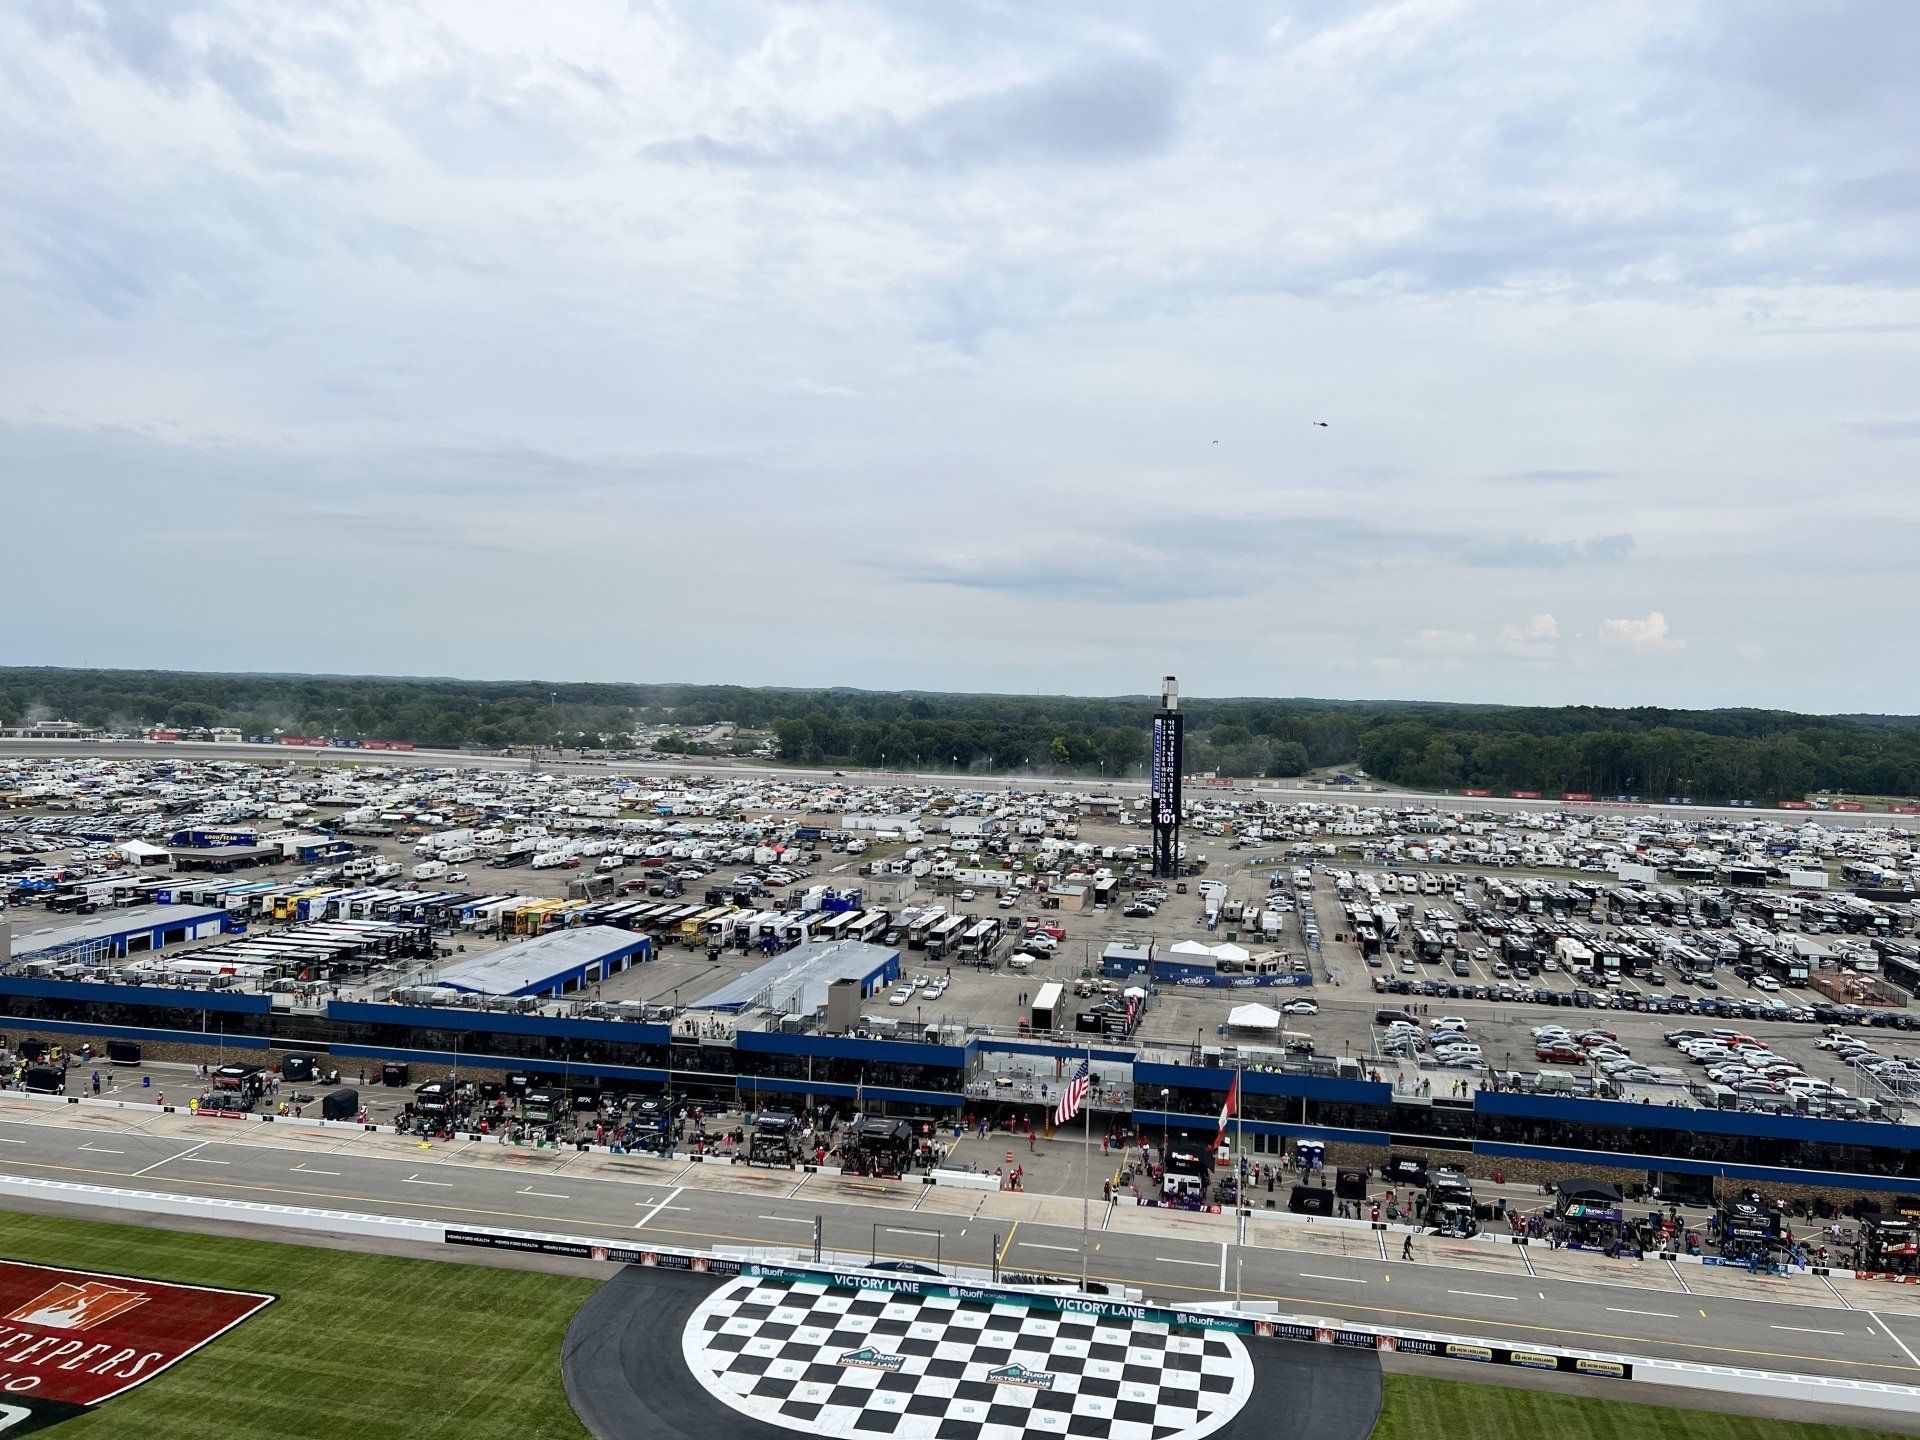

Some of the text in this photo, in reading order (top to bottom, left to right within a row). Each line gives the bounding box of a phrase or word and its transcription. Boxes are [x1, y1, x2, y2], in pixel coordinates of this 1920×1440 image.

[1158, 814, 1175, 824] 101
[1172, 1152, 1199, 1161] FedEx
[1888, 1243, 1905, 1251] BLASTER
[762, 1267, 784, 1277] Ruoff
[834, 1275, 919, 1293] VICTORY LANE
[960, 1289, 984, 1299] Ruoff
[1054, 1298, 1145, 1319] VICTORY LANE
[1189, 1315, 1215, 1326] Ruoff
[990, 1375, 1026, 1383] VICTORY
[1022, 1371, 1053, 1379] Ruoff
